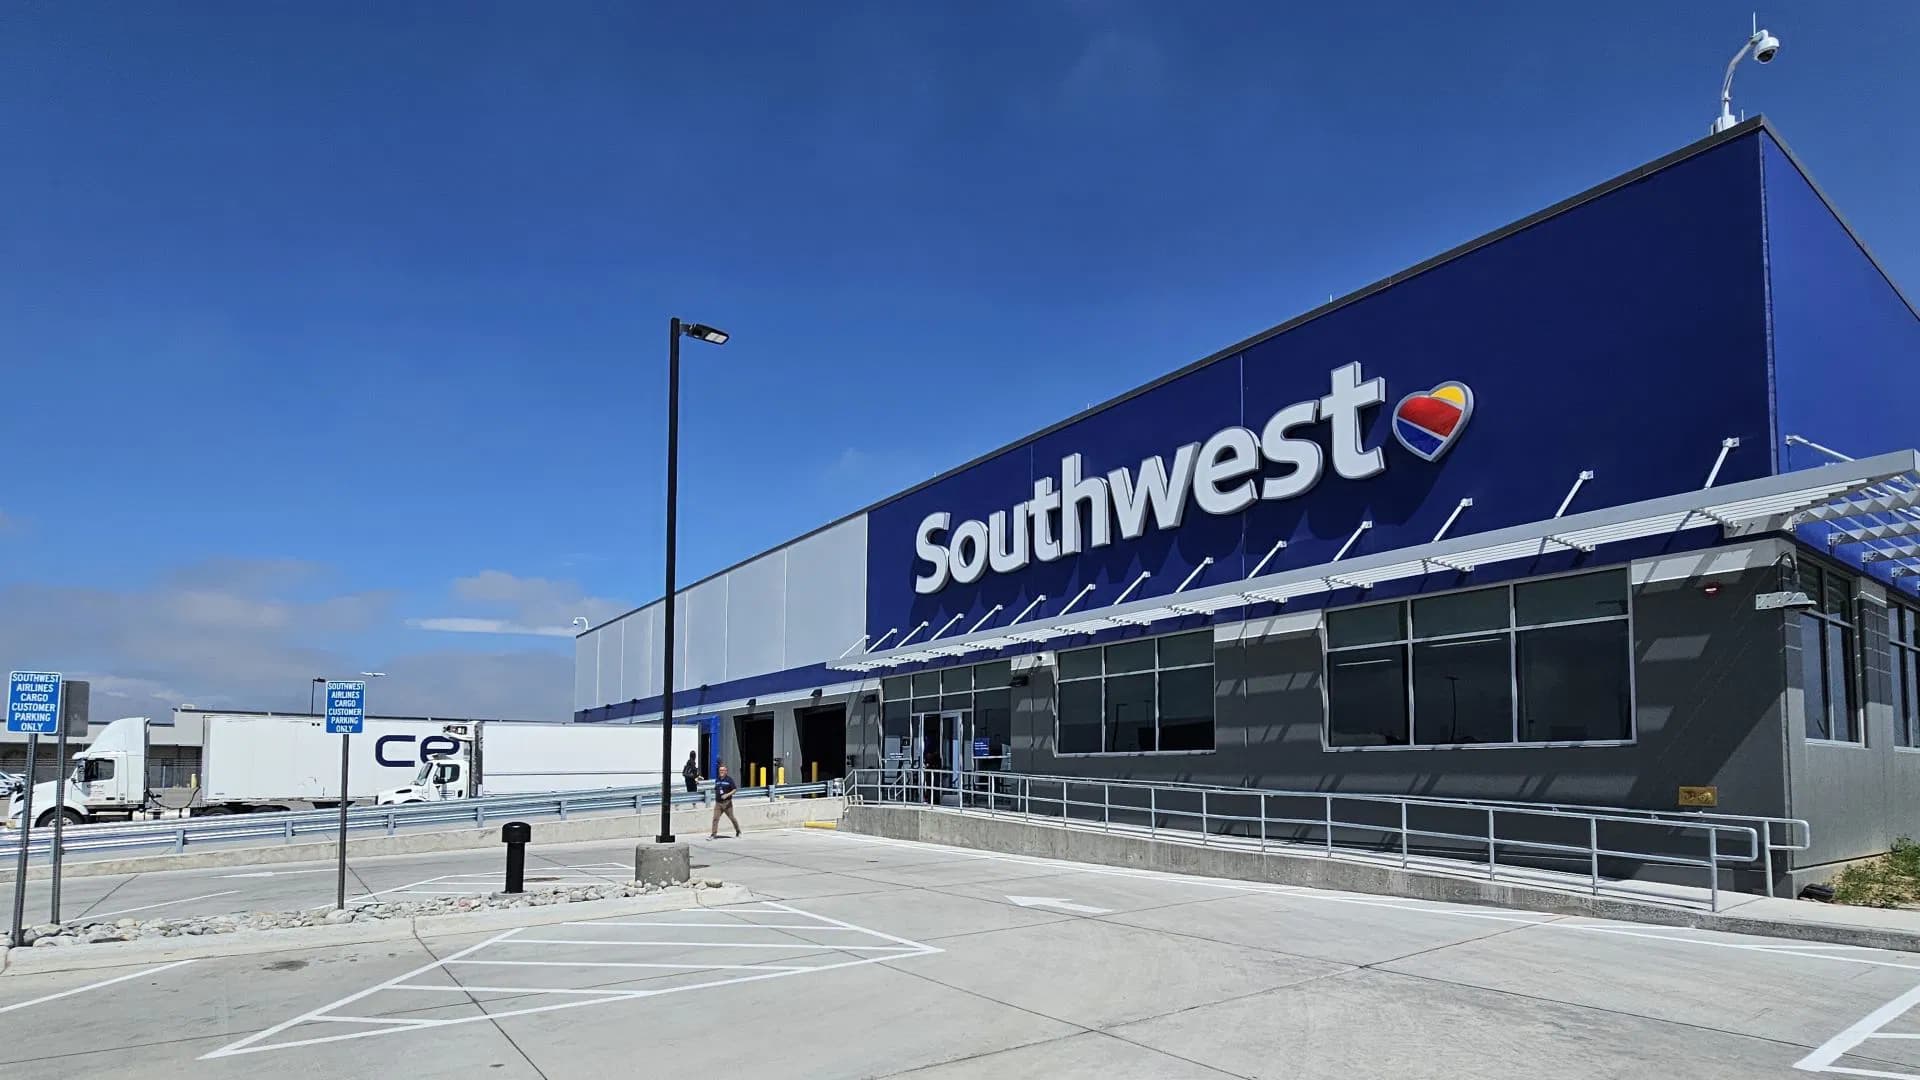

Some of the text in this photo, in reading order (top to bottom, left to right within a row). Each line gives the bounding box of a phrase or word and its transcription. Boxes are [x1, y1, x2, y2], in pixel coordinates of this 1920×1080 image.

[915, 361, 1385, 594] Southwest
[12, 674, 59, 682] SOUTHWEST
[16, 683, 54, 692] AIRLINES
[20, 693, 48, 702] CARGO
[11, 703, 56, 711] CUSTOMER
[328, 708, 362, 716] CUSTOMER
[14, 713, 51, 721] PARKING
[21, 722, 43, 731] ONLY
